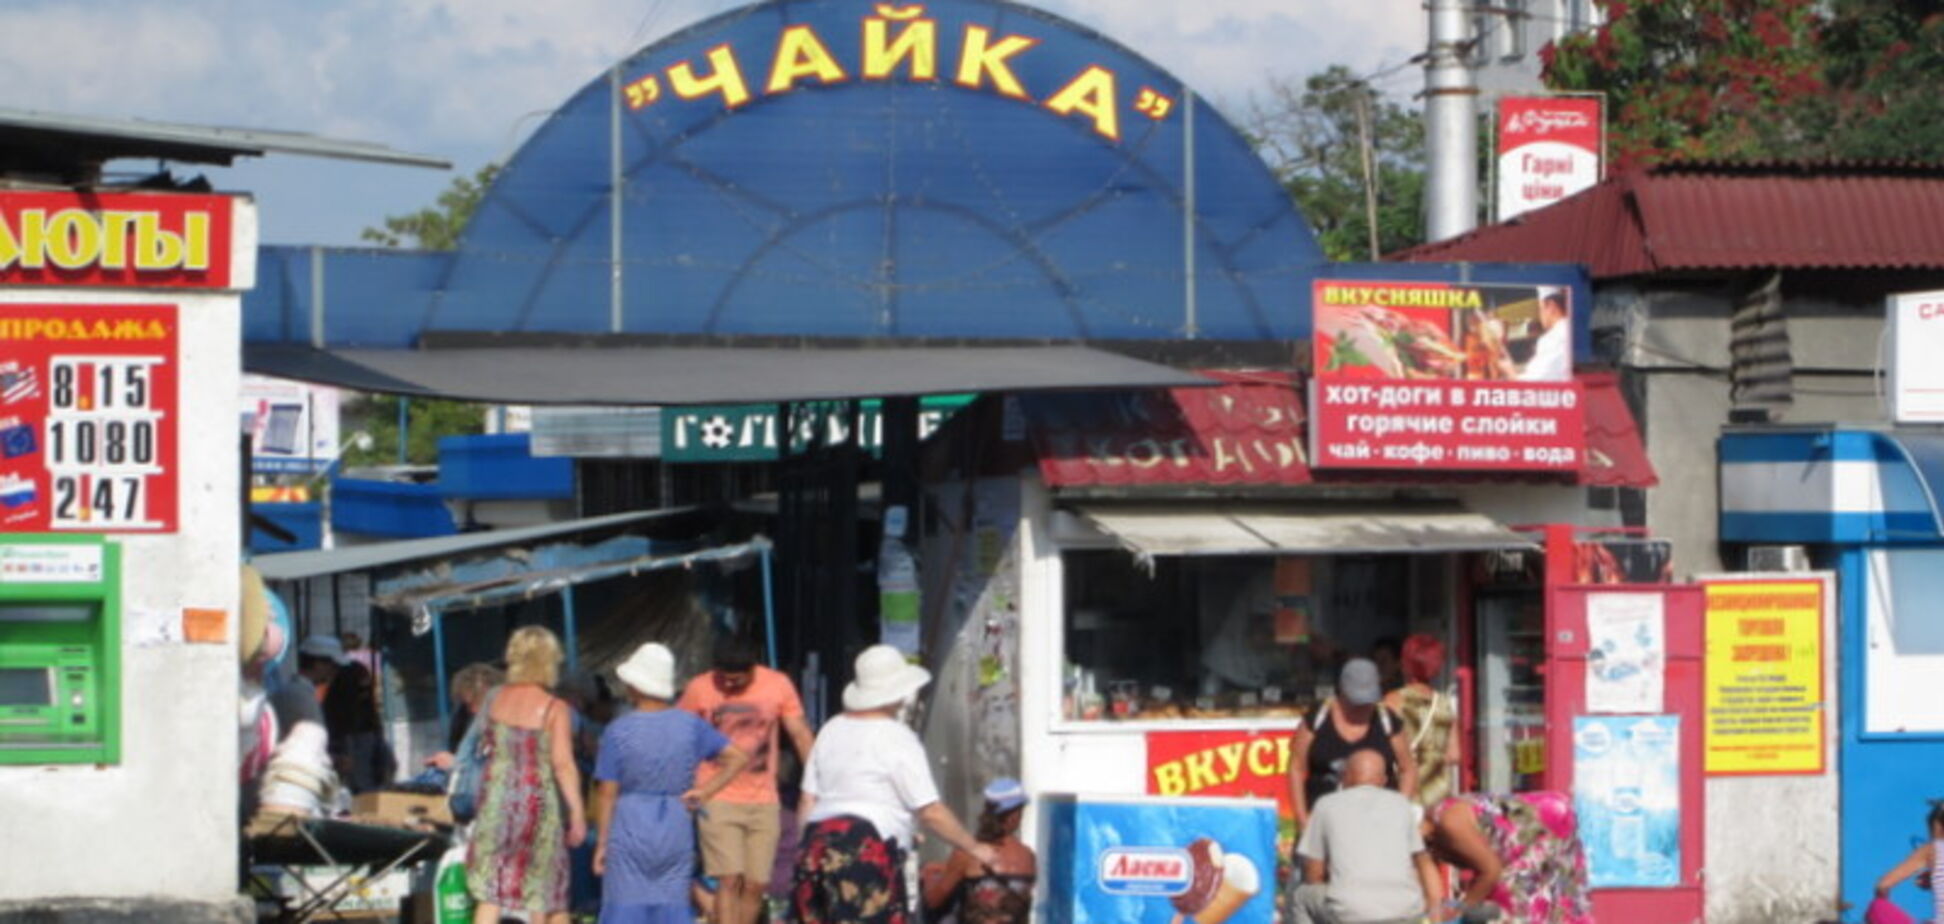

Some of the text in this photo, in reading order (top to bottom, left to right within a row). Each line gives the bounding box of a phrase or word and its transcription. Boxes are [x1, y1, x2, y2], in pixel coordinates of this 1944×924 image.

[1522, 153, 1573, 177] Гарні
[1325, 286, 1482, 308] ВКУСНЯШКА
[0, 318, 167, 339] ПРОДАЖА
[1326, 386, 1442, 409] хот-доги
[1450, 388, 1466, 406] в
[1473, 388, 1576, 408] лаваше
[1347, 413, 1557, 438] горячие слойки
[1329, 441, 1575, 465] чай кофе пиво вода
